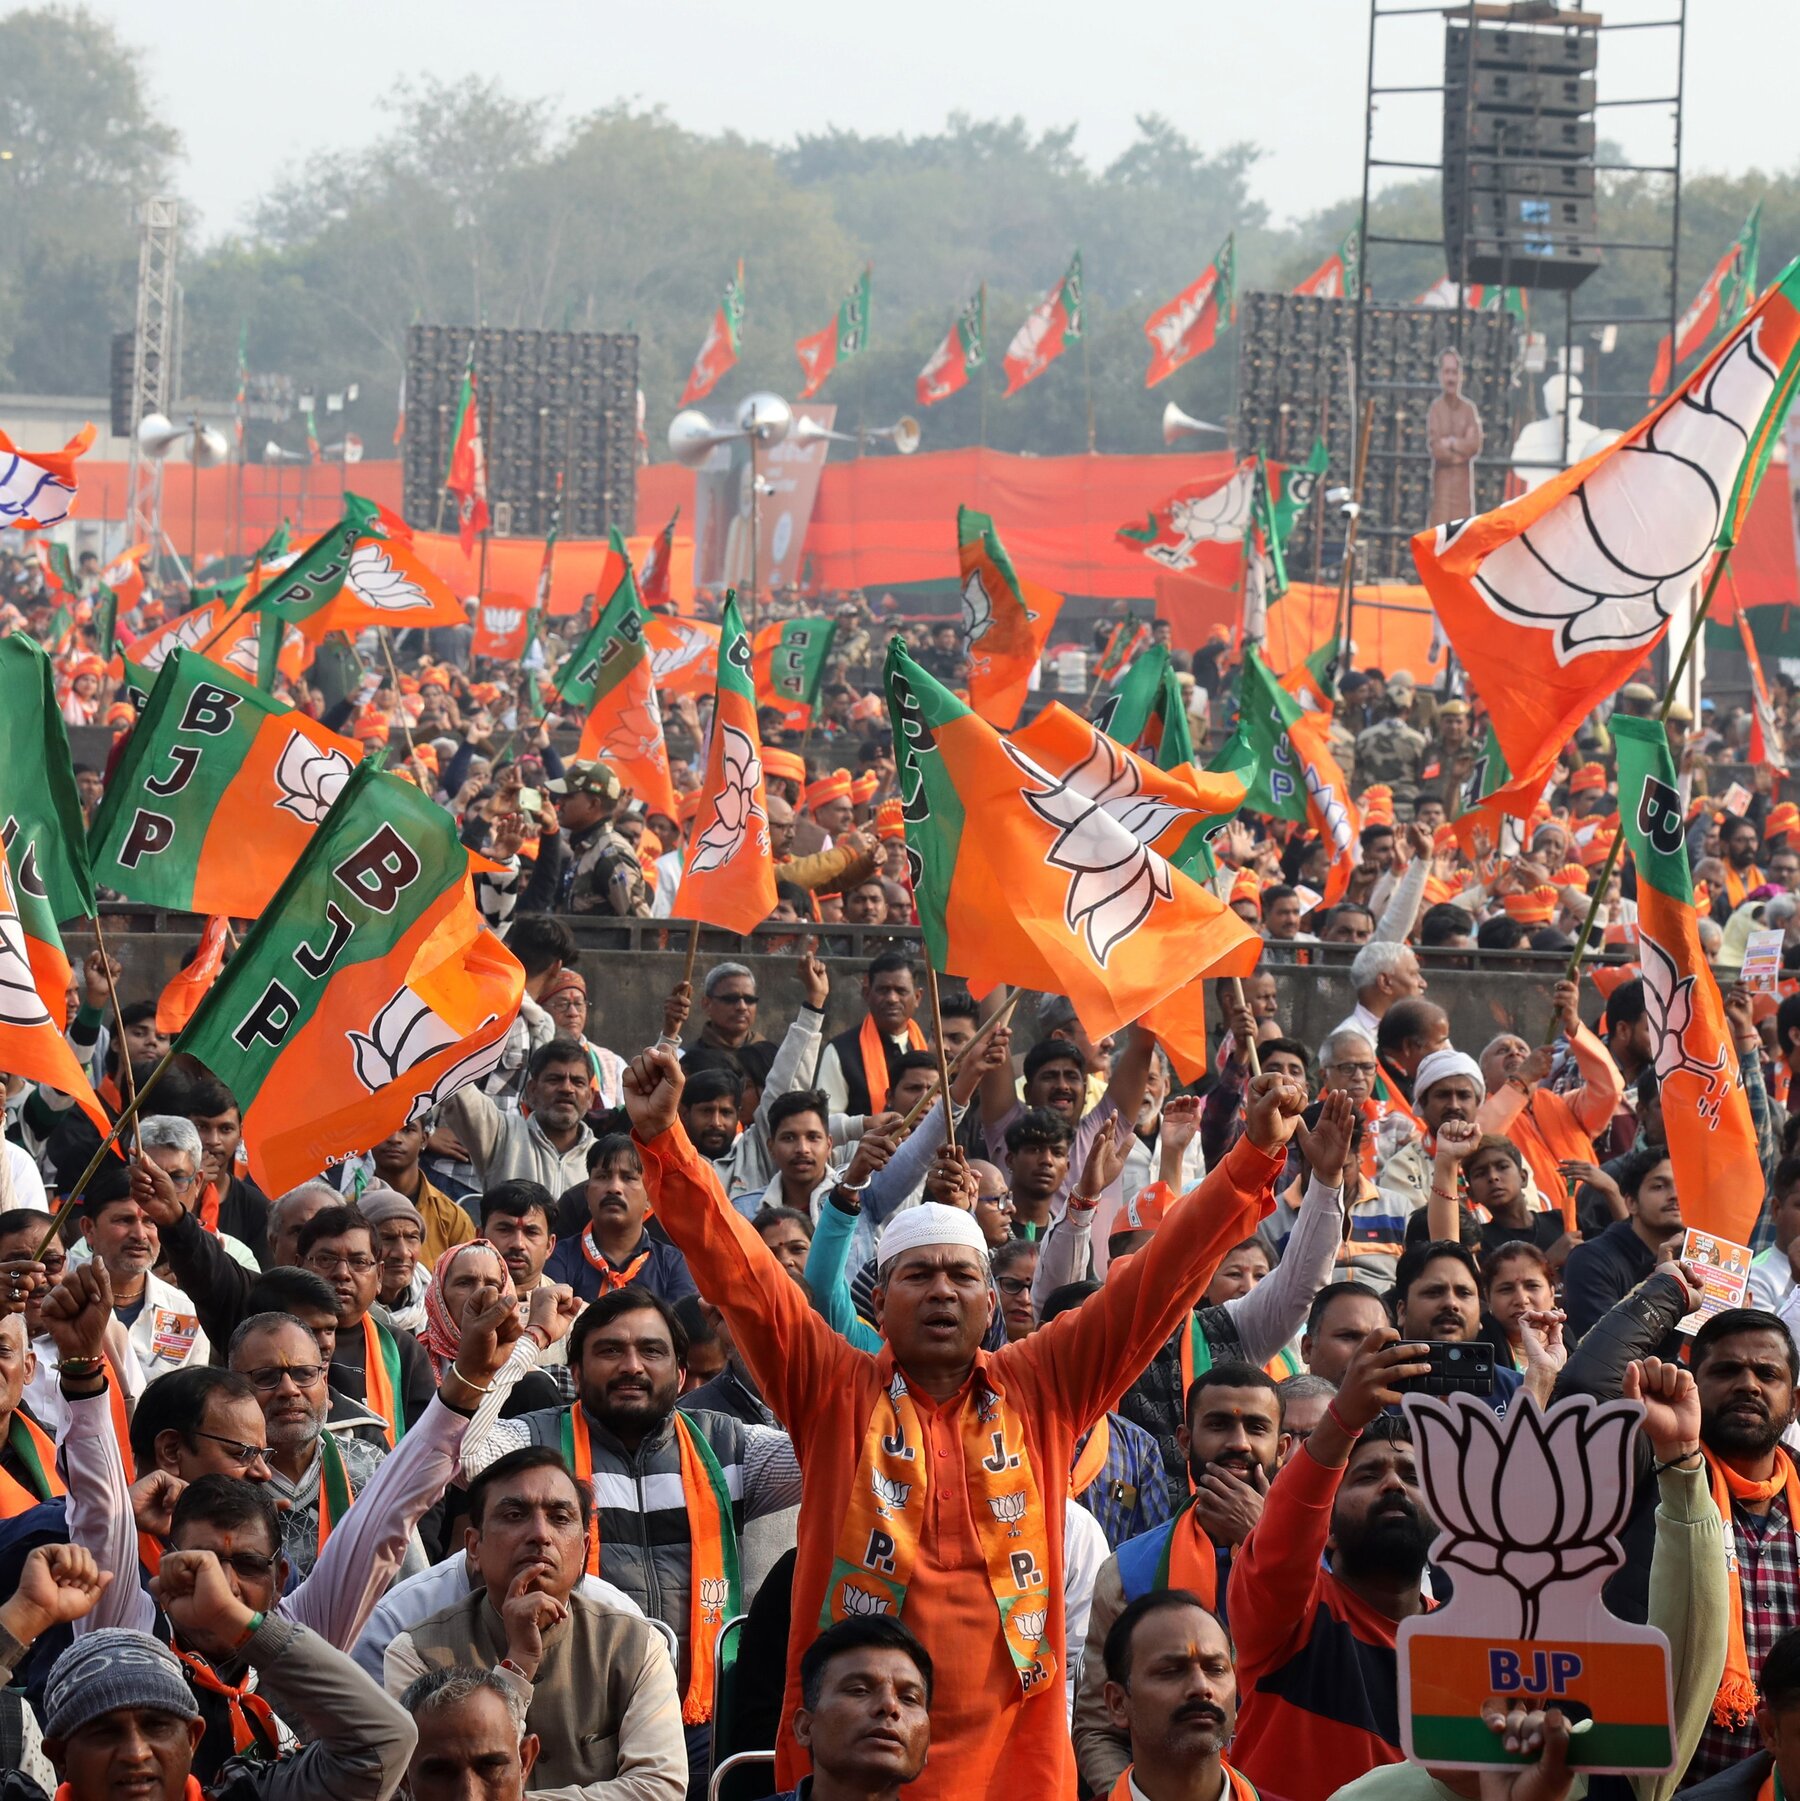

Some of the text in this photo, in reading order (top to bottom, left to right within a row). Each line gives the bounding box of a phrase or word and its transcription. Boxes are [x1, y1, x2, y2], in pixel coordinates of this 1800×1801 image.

[117, 681, 244, 870] BJP
[232, 821, 421, 1052] BJP
[1488, 1648, 1583, 1695] BJP
